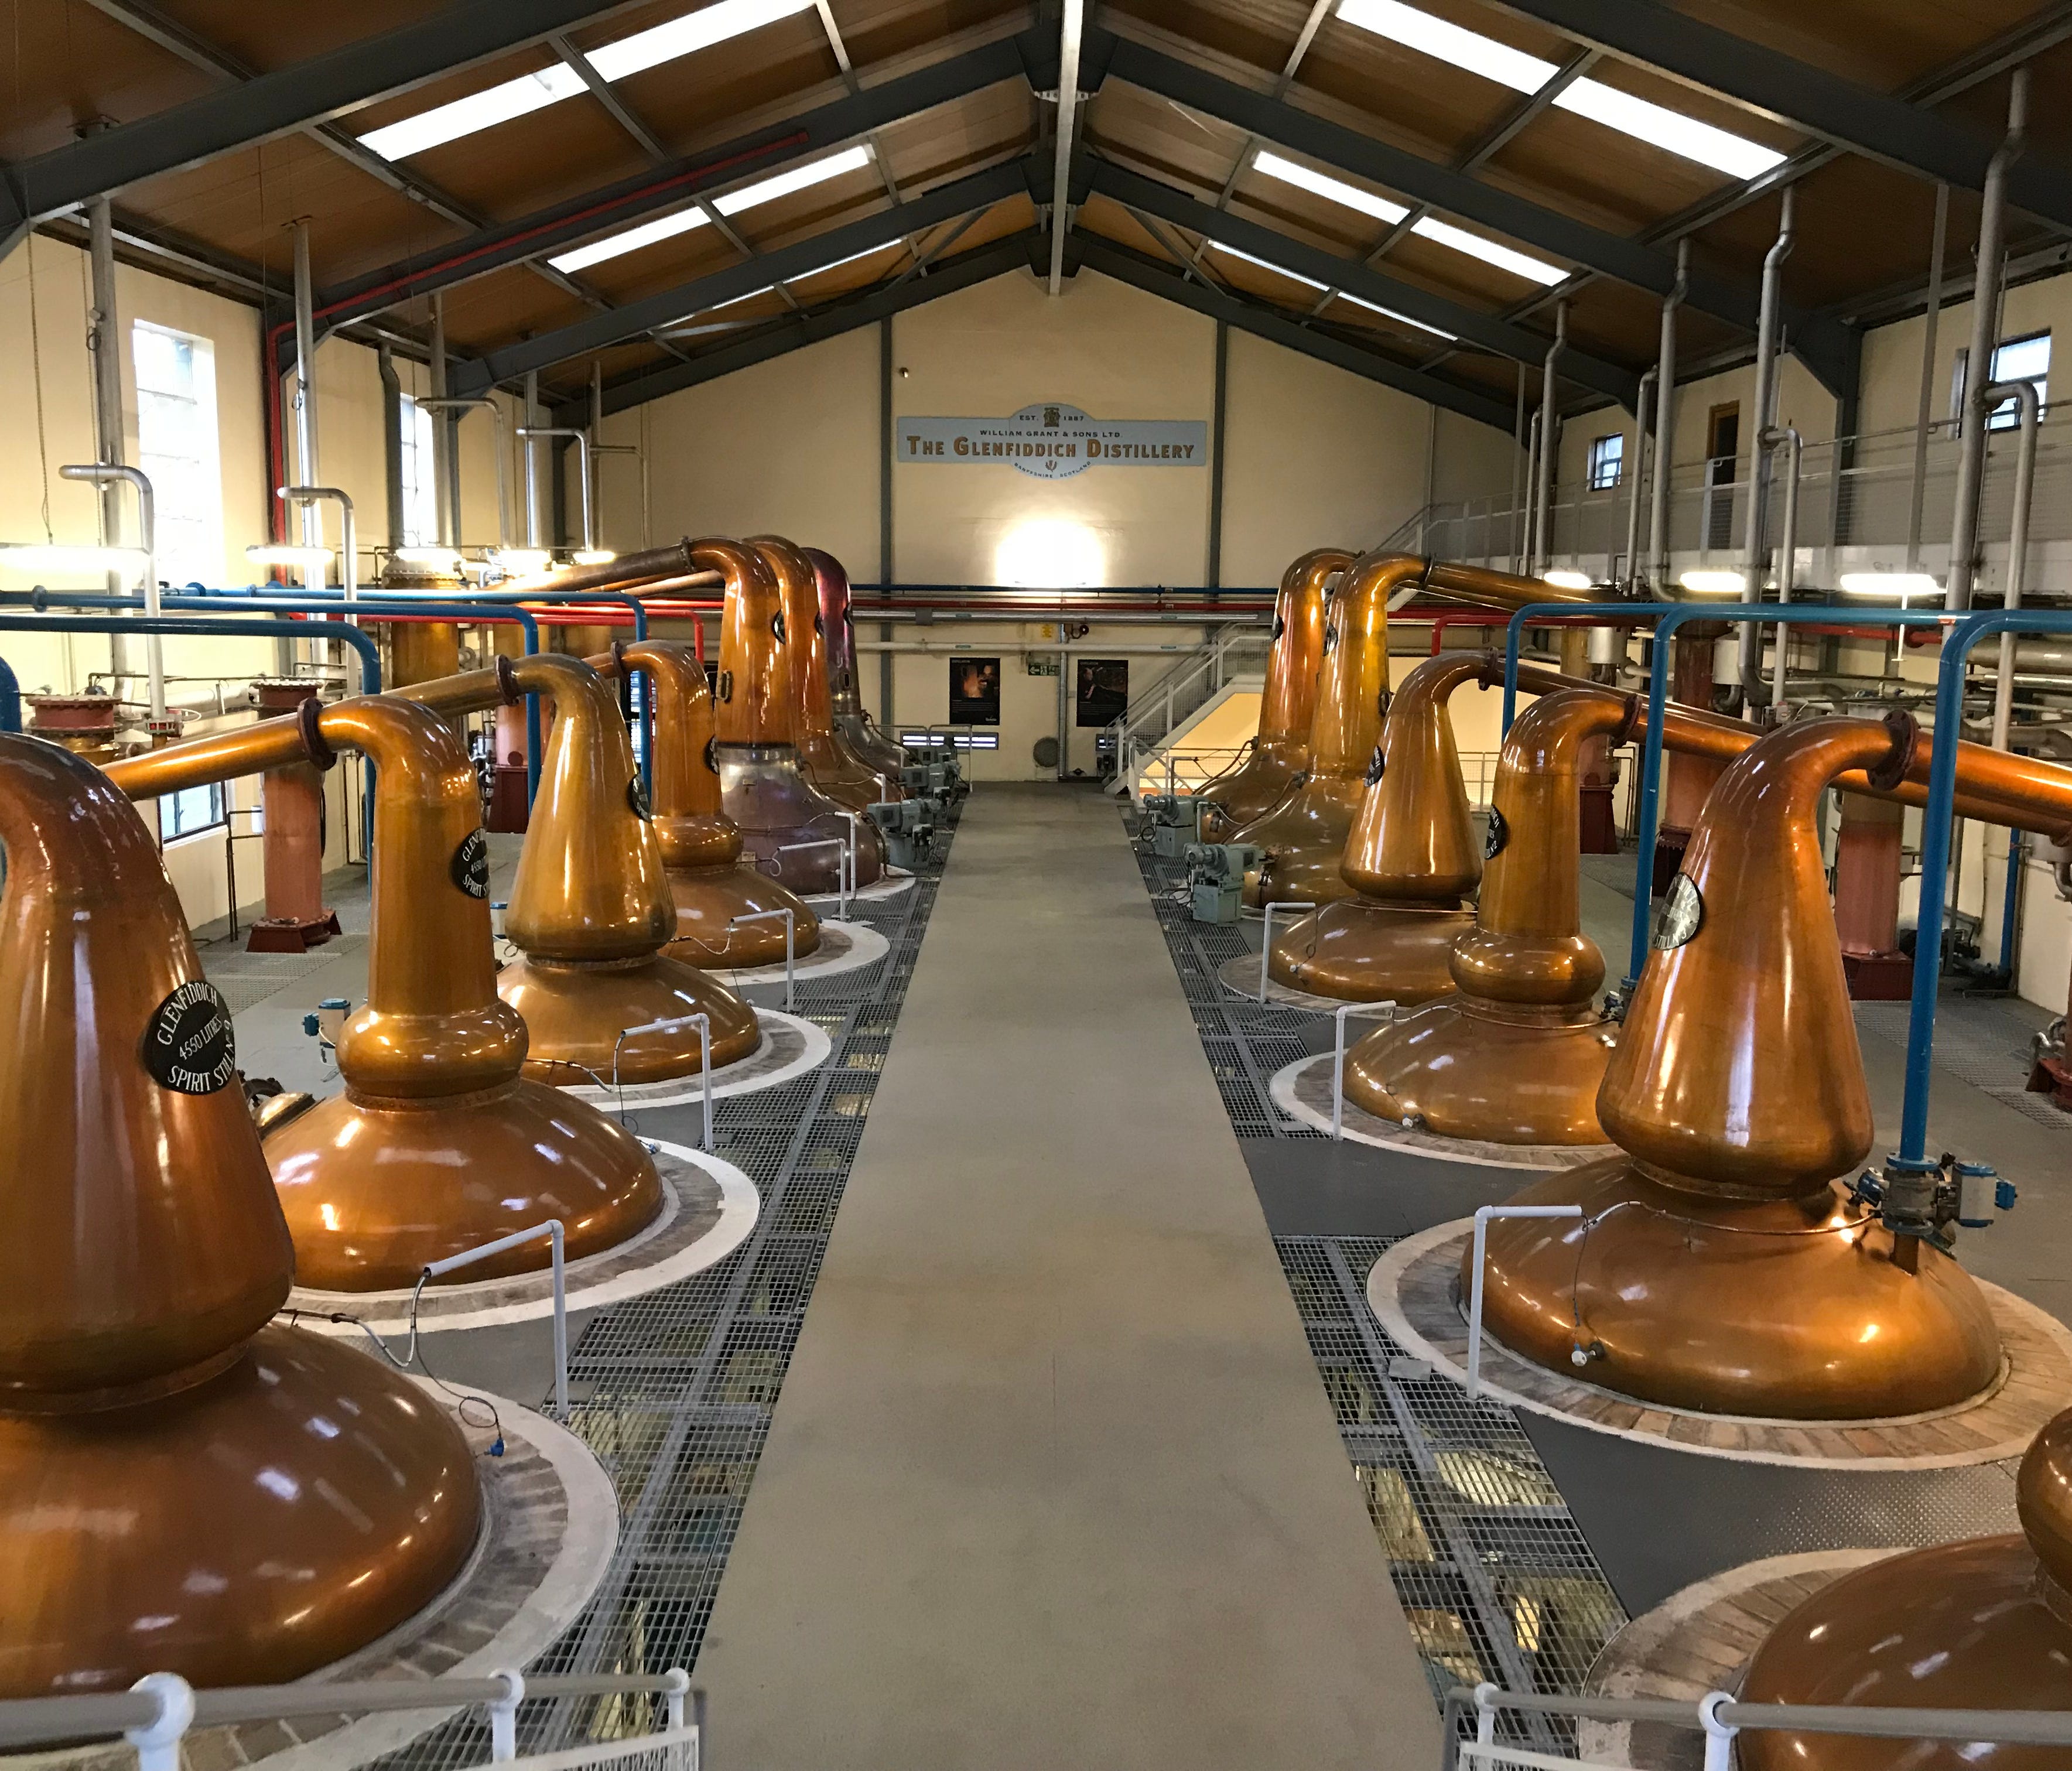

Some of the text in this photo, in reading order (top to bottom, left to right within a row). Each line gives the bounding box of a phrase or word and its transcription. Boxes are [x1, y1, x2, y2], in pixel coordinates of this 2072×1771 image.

[953, 436, 1076, 457] GLENFIDDICH
[1086, 439, 1195, 459] DISTILLERY
[1014, 461, 1091, 478] BANFFSHIRE SCOTLAND
[157, 982, 218, 1045] GLENFIDDICH
[179, 1013, 222, 1061] 4550 LITRES
[167, 1065, 211, 1092] SPIRIT
[213, 1051, 234, 1086] STILL
